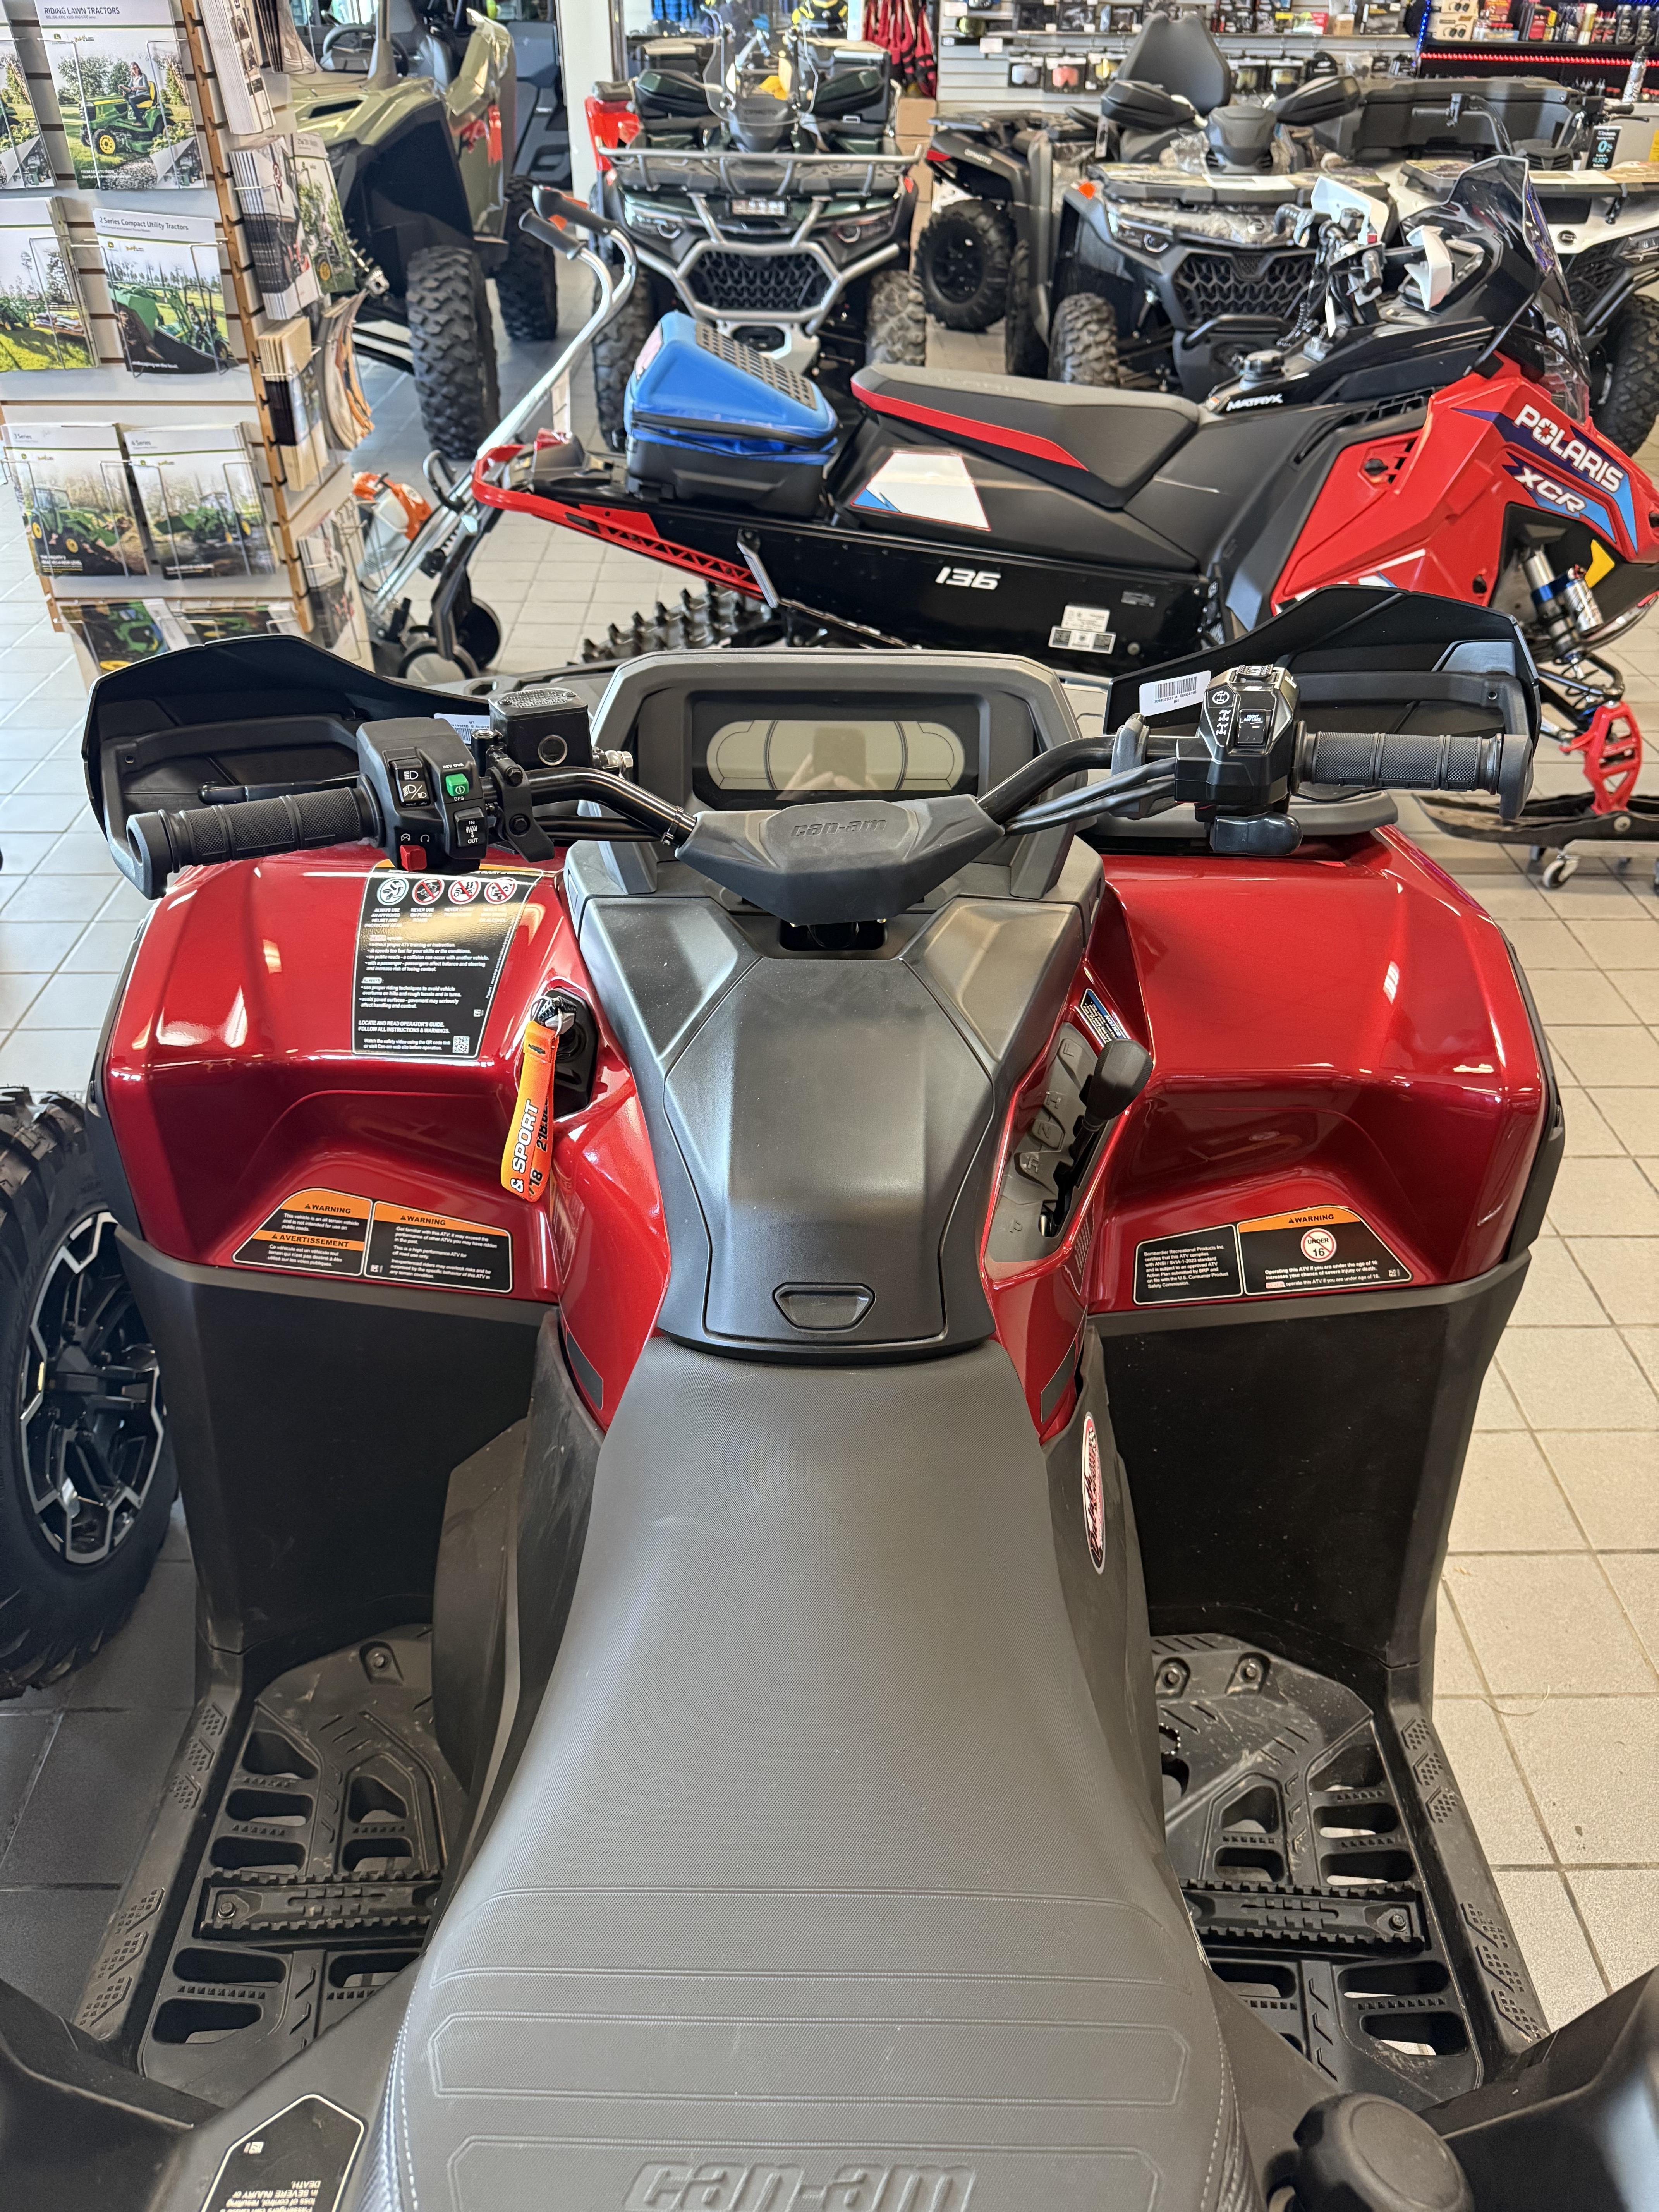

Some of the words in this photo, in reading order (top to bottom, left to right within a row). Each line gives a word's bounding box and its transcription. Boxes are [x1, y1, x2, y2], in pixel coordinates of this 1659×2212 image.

[121, 219, 145, 227] Compact
[147, 221, 164, 230] Utility
[1226, 393, 1283, 411] MATRYX
[1513, 404, 1626, 494] POLARIS
[1514, 467, 1587, 514] XCR
[935, 566, 1001, 591] 136
[790, 819, 887, 837] can-am
[1104, 1015, 1122, 1038] NOTICE
[513, 1098, 539, 1174] SPORT
[510, 1178, 524, 1193] &
[312, 1204, 351, 1214] WARNING
[407, 1216, 446, 1226] WARNING
[1295, 1214, 1334, 1223] WARNING
[279, 1234, 349, 1247] AVERTISSEMENT
[1313, 1248, 1325, 1256] 16
[291, 2180, 321, 2189] DEATH.
[623, 2162, 976, 2212] can-am
[241, 2190, 273, 2199] INJURY
[274, 2189, 309, 2198] SEVERE
[299, 2198, 316, 2206] loss
